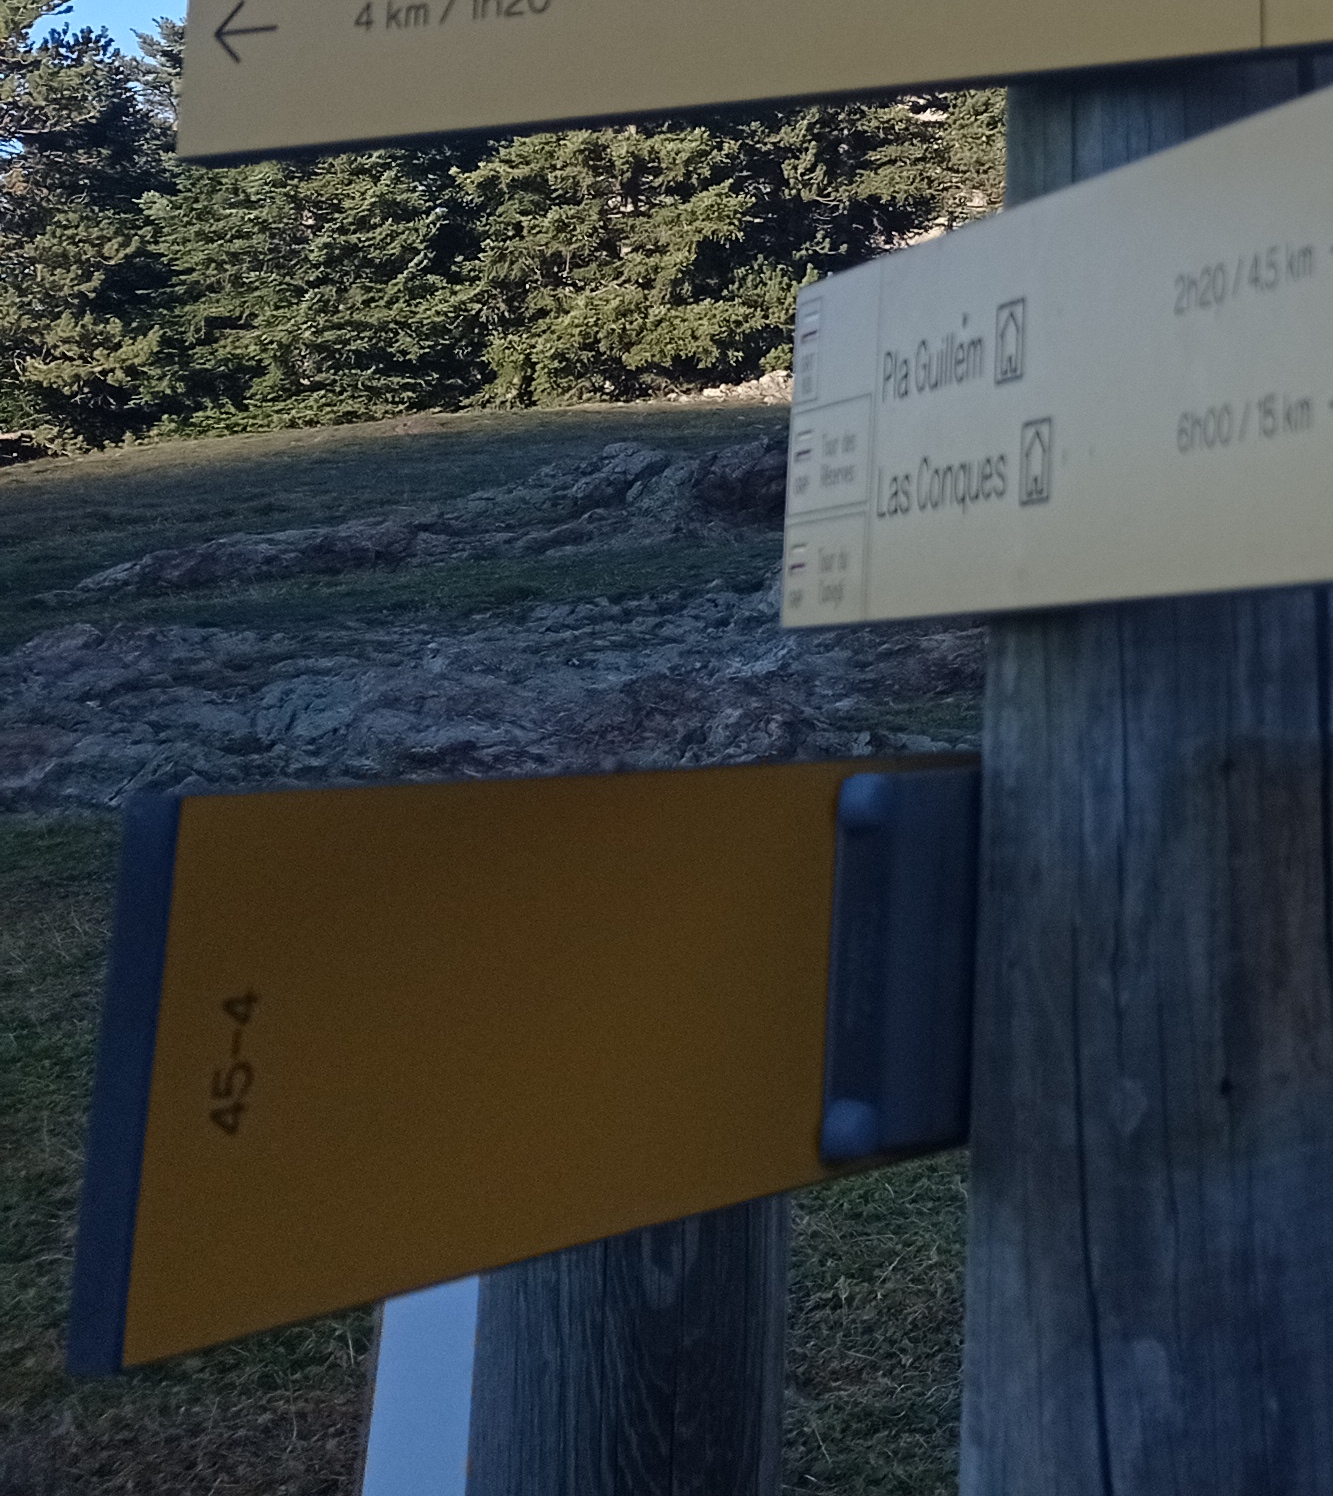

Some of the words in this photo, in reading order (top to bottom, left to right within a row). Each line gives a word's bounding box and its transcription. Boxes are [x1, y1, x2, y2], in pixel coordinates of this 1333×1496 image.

[353, 1, 375, 33] 4
[1173, 261, 1226, 317] 2h20
[1232, 256, 1245, 298] /
[1284, 241, 1315, 284] km
[882, 351, 909, 403] Pla
[1176, 403, 1233, 455] 6h00
[1238, 401, 1250, 444] /
[1282, 392, 1315, 433] km
[876, 466, 911, 519] Las
[916, 455, 1006, 515] Conques
[208, 991, 259, 1136] 45-4
